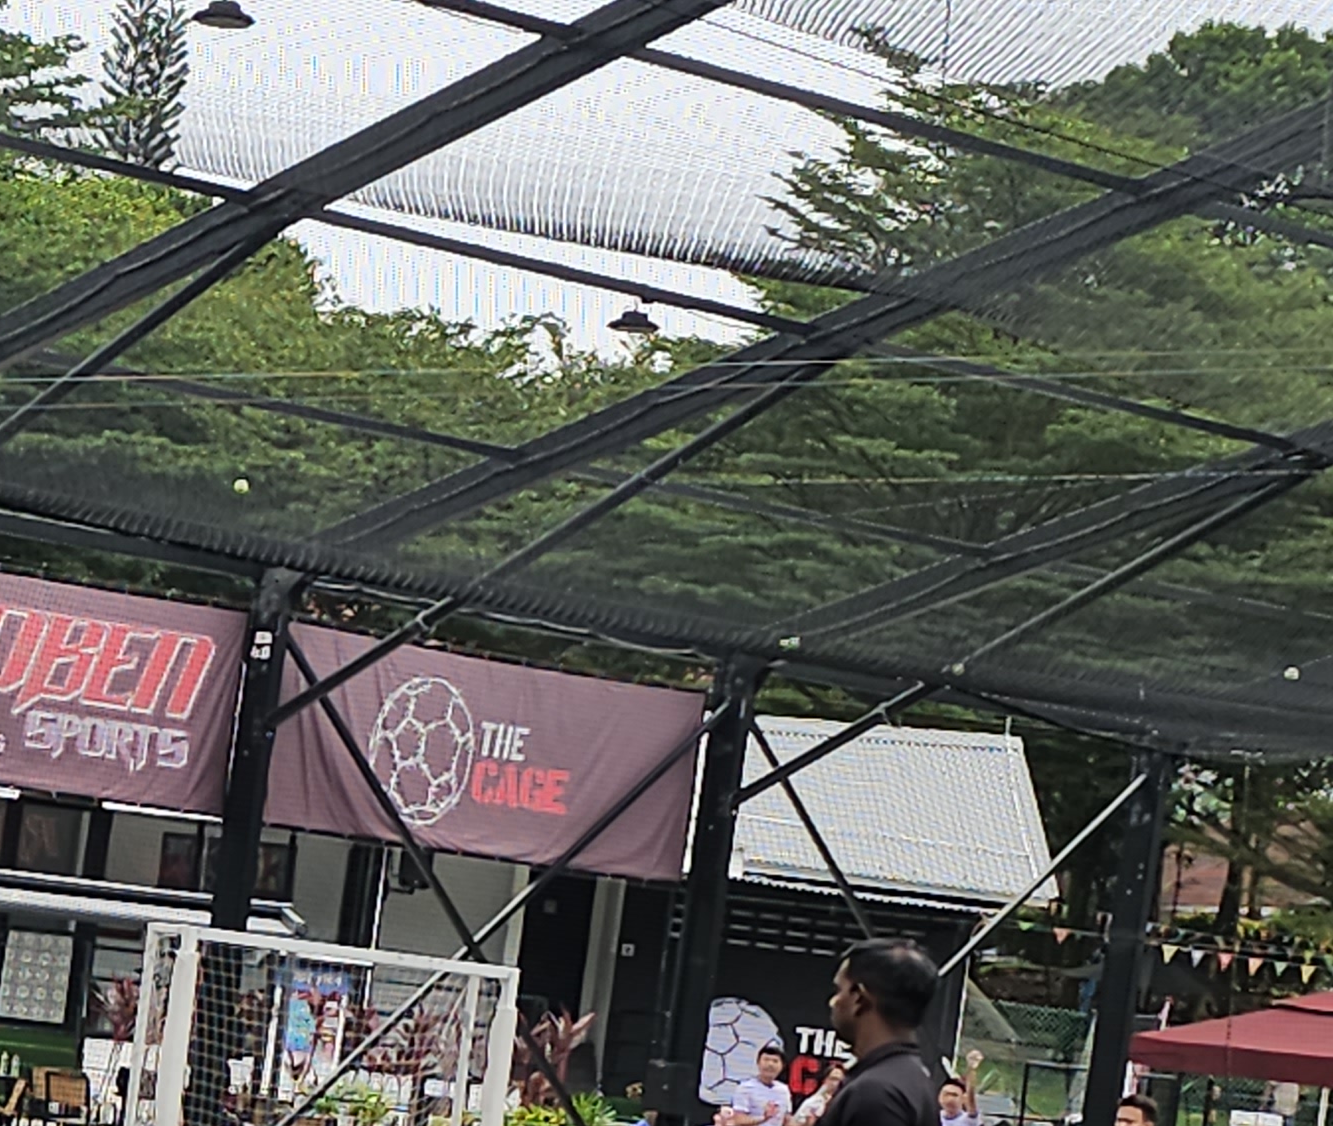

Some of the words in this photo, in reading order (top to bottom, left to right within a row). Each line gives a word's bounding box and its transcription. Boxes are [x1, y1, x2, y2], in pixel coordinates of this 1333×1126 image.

[24, 710, 190, 772] SPORTS
[481, 720, 531, 760] THE
[471, 759, 570, 815] CAGE
